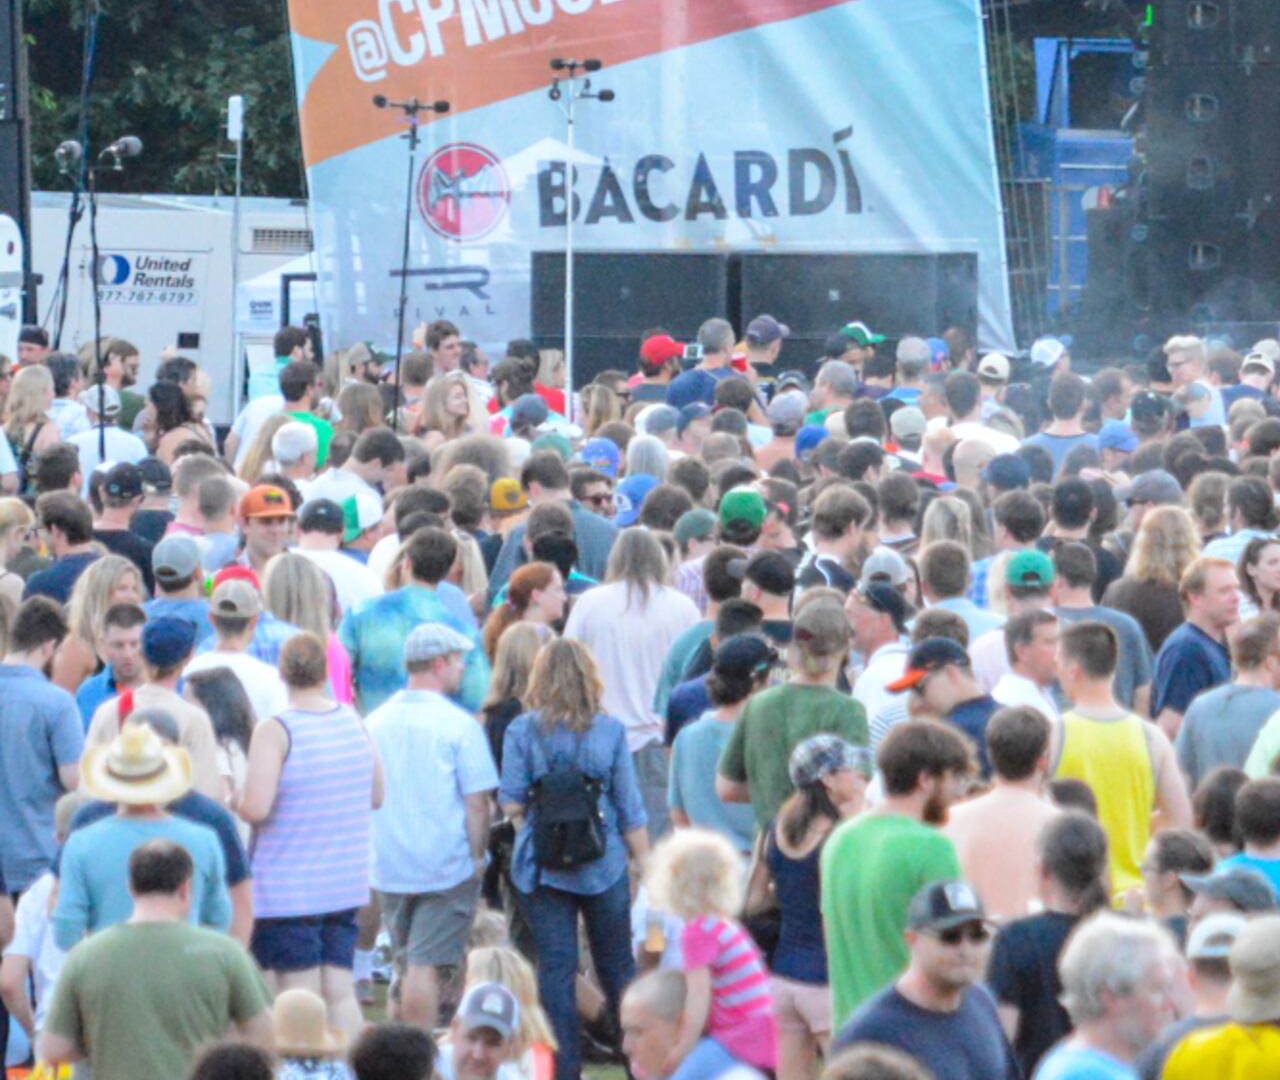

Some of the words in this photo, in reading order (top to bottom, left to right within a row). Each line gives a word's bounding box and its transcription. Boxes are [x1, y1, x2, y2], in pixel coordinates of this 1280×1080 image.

[537, 123, 864, 227] BACARDÍ
[134, 256, 193, 272] United
[133, 272, 196, 288] Rentals
